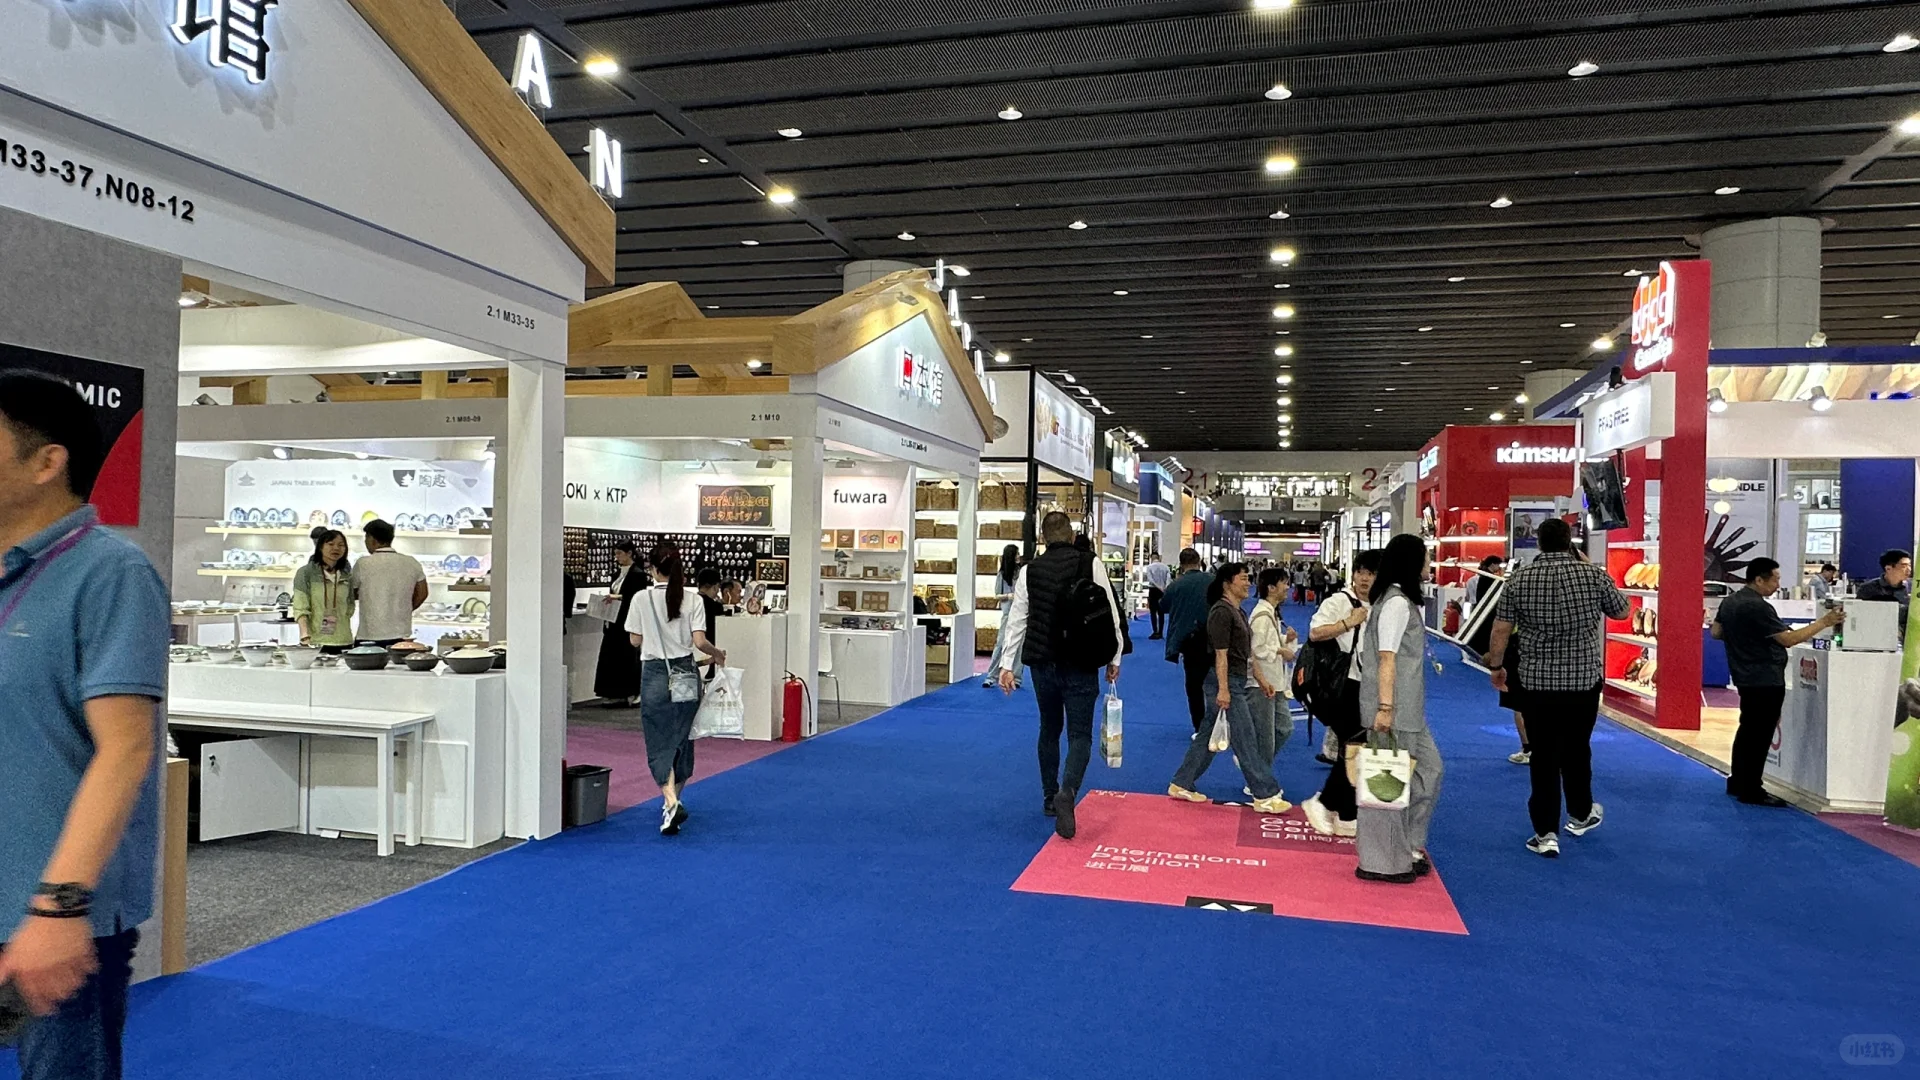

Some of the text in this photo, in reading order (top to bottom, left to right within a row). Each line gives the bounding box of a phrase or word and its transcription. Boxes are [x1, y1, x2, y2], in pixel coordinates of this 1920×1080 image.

[74, 381, 121, 409] MIC
[563, 482, 587, 500] OKI
[606, 487, 628, 504] KTP
[701, 496, 735, 507] METAL
[833, 489, 887, 504] fuwara
[1090, 852, 1200, 869] Pavilion
[1095, 844, 1267, 868] International
